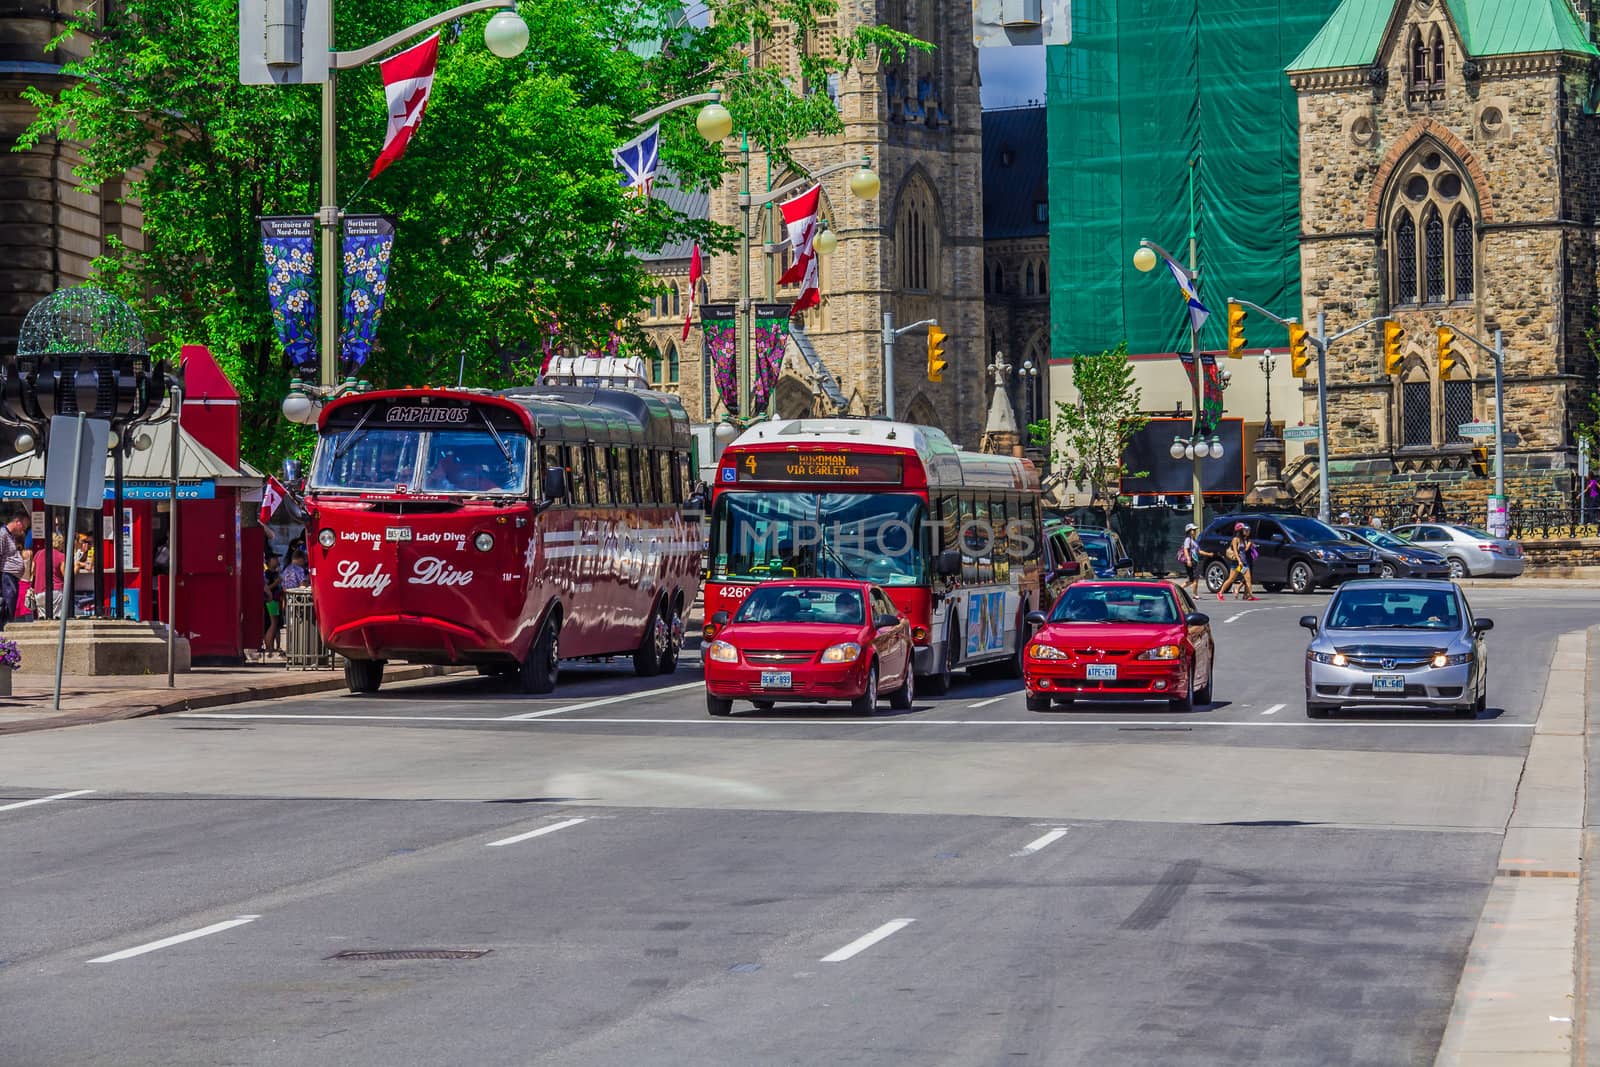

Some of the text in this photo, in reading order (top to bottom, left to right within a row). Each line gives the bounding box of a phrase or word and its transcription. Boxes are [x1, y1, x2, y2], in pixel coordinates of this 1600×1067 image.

[386, 406, 469, 423] AMPHIBUS
[745, 455, 758, 475] 4
[786, 466, 859, 476] VIA CARLETON
[3, 489, 27, 497] and
[340, 531, 381, 543] Lady Dive
[416, 532, 466, 543] Lady Dive
[408, 556, 474, 586] Dive
[333, 560, 392, 597] Lady
